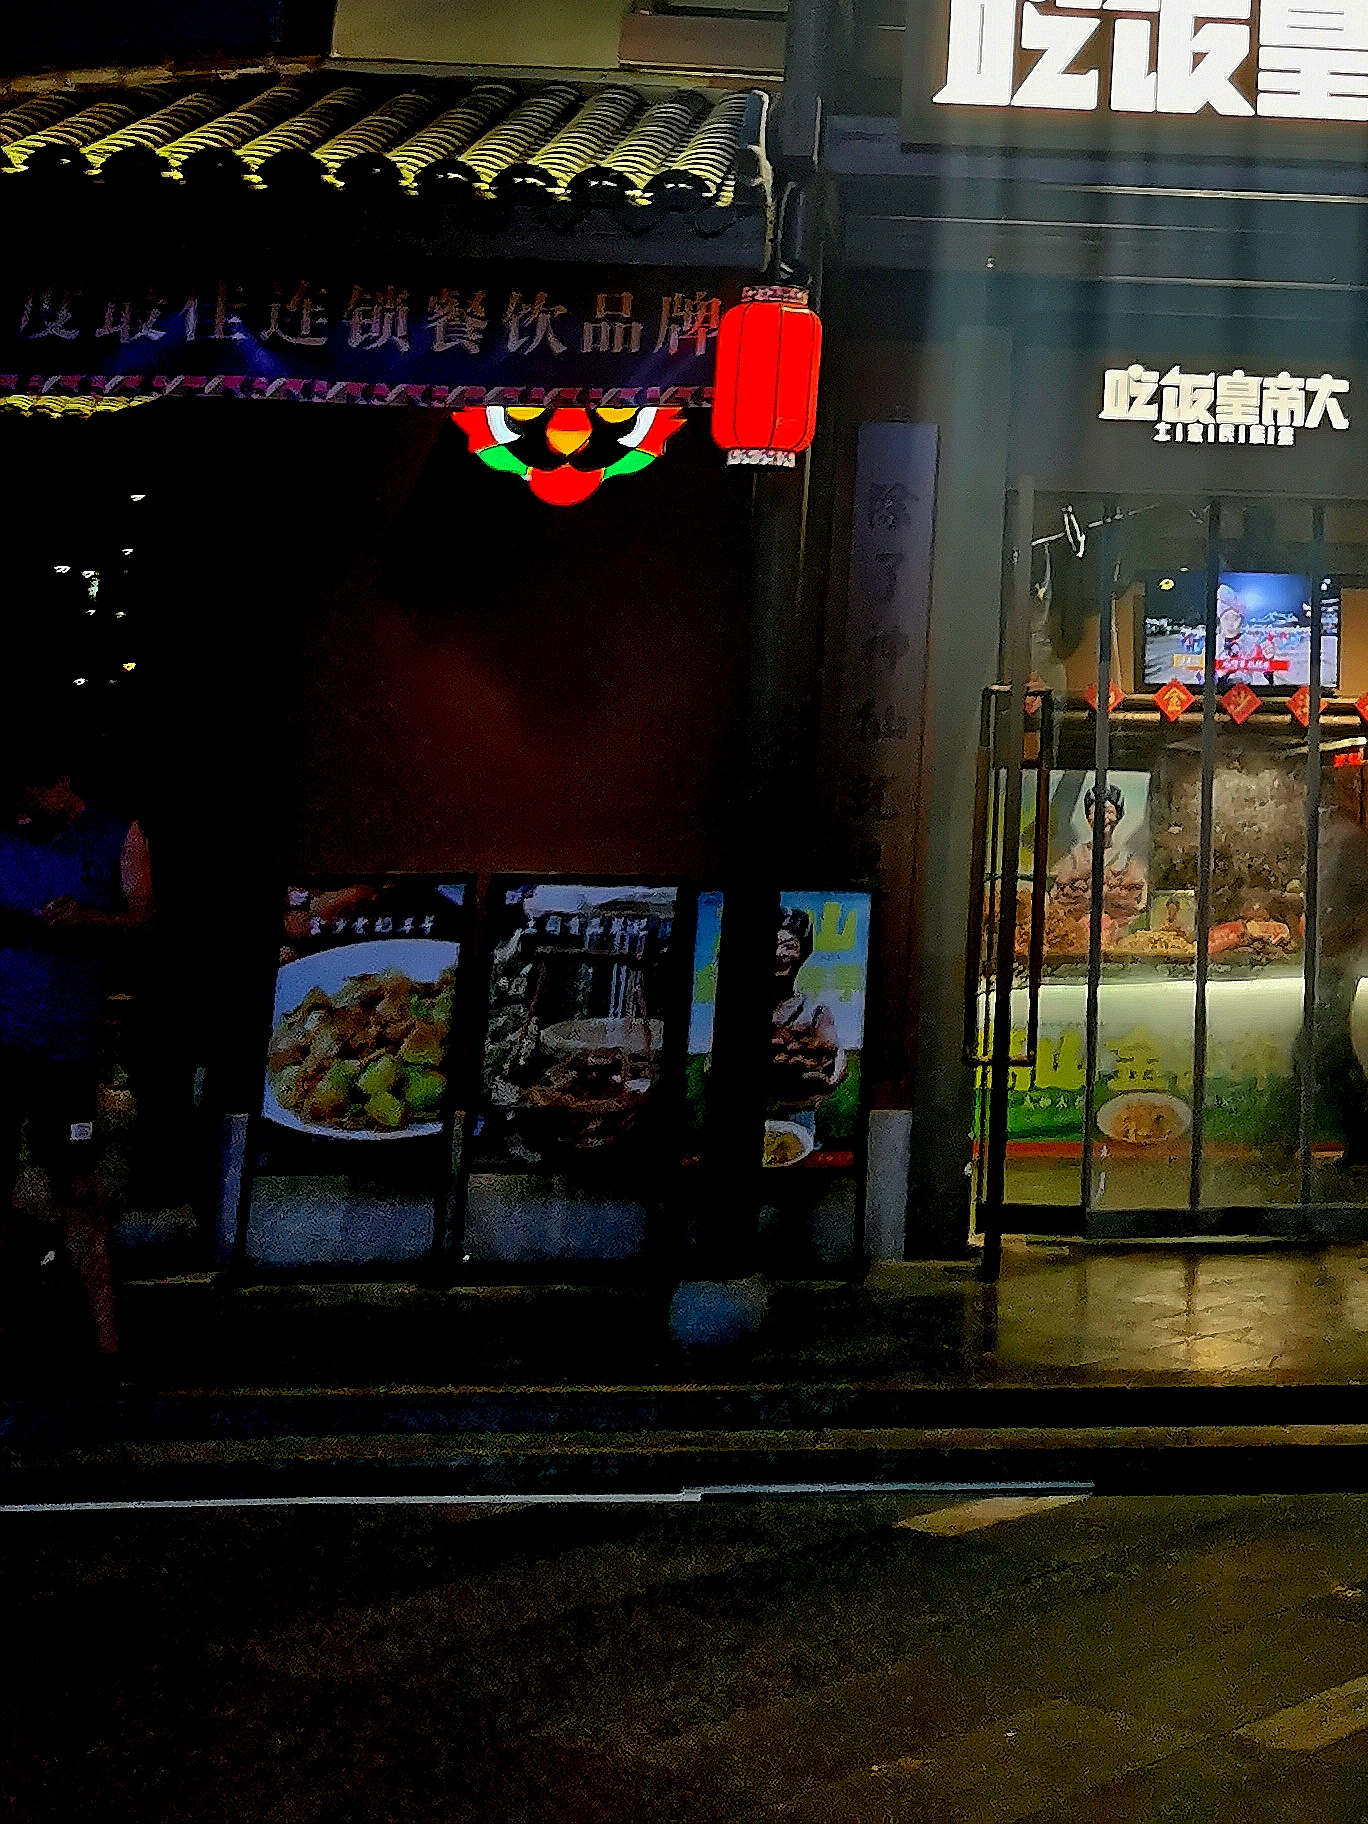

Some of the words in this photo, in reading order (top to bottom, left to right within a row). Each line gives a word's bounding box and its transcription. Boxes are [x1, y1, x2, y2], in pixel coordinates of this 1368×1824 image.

[1097, 362, 1351, 431] 吃饭皇帝大
